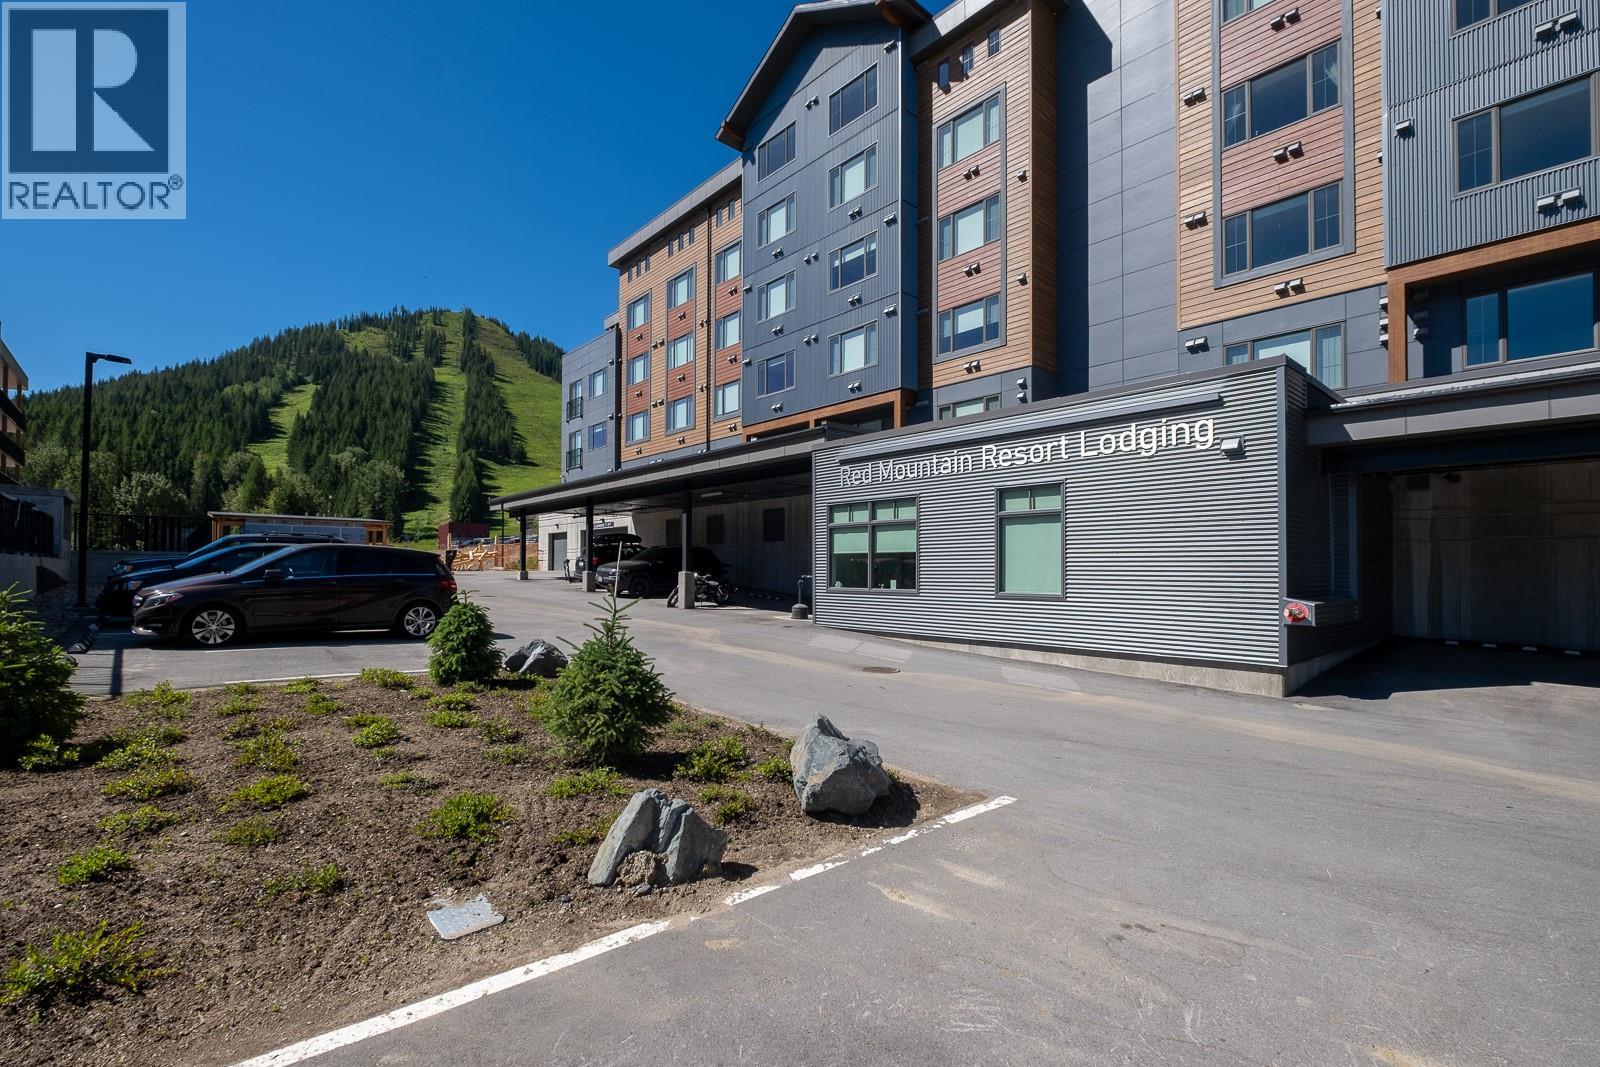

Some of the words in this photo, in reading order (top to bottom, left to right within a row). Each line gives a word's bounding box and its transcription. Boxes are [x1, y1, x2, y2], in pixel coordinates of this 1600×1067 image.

[840, 462, 872, 488] Red
[879, 449, 973, 482] Mountain
[982, 435, 1069, 470] Resort
[1080, 417, 1215, 457] Lodging
